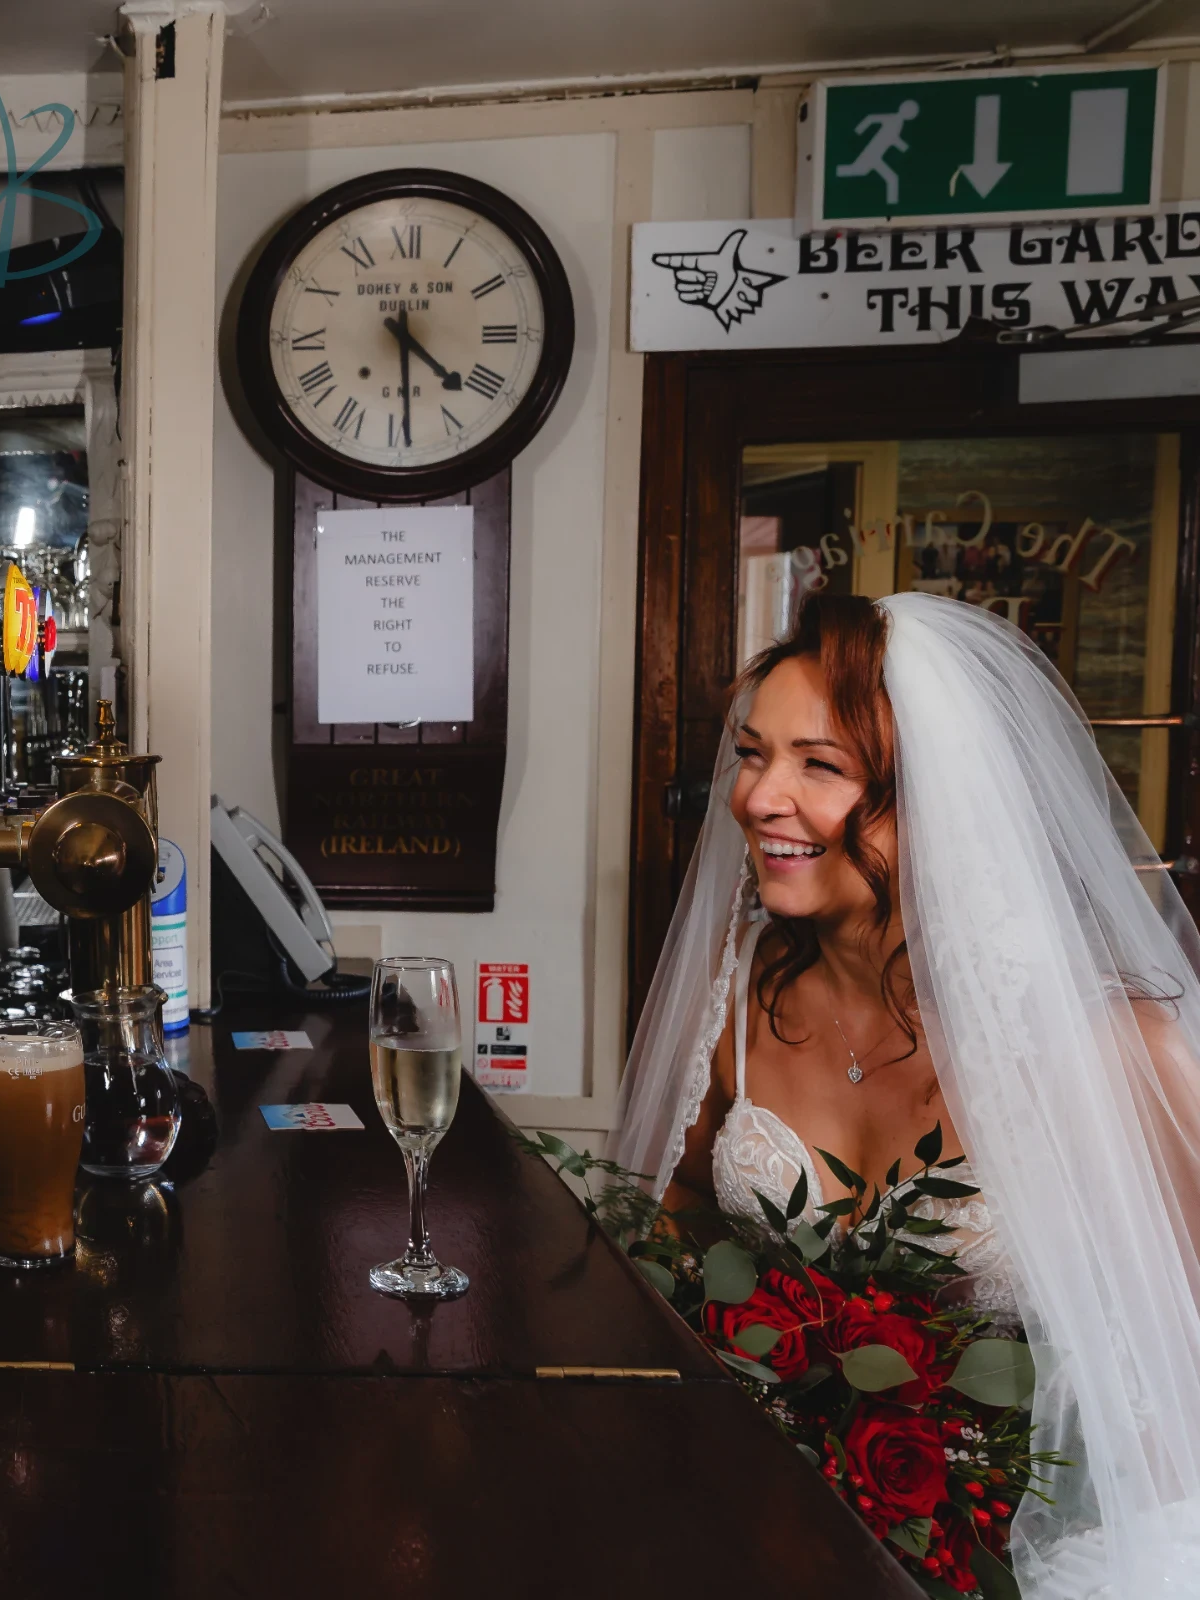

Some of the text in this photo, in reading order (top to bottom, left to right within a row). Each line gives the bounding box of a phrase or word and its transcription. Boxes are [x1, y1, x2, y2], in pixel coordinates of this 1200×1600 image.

[798, 228, 983, 274] BEER
[357, 281, 453, 296] DOHEY & SON
[379, 299, 429, 312] DUBLIN
[867, 282, 1033, 332] THIS
[380, 530, 405, 542] THE
[344, 552, 442, 565] MANAGEMENT
[365, 575, 421, 587] RESERVE
[380, 597, 405, 609] THE
[373, 619, 412, 630] RIGHT
[384, 641, 402, 652] TO
[366, 662, 418, 675] REFUSE.
[349, 767, 445, 786] GREAT
[319, 833, 463, 859] (IRELAND)
[487, 964, 520, 973] WATER
